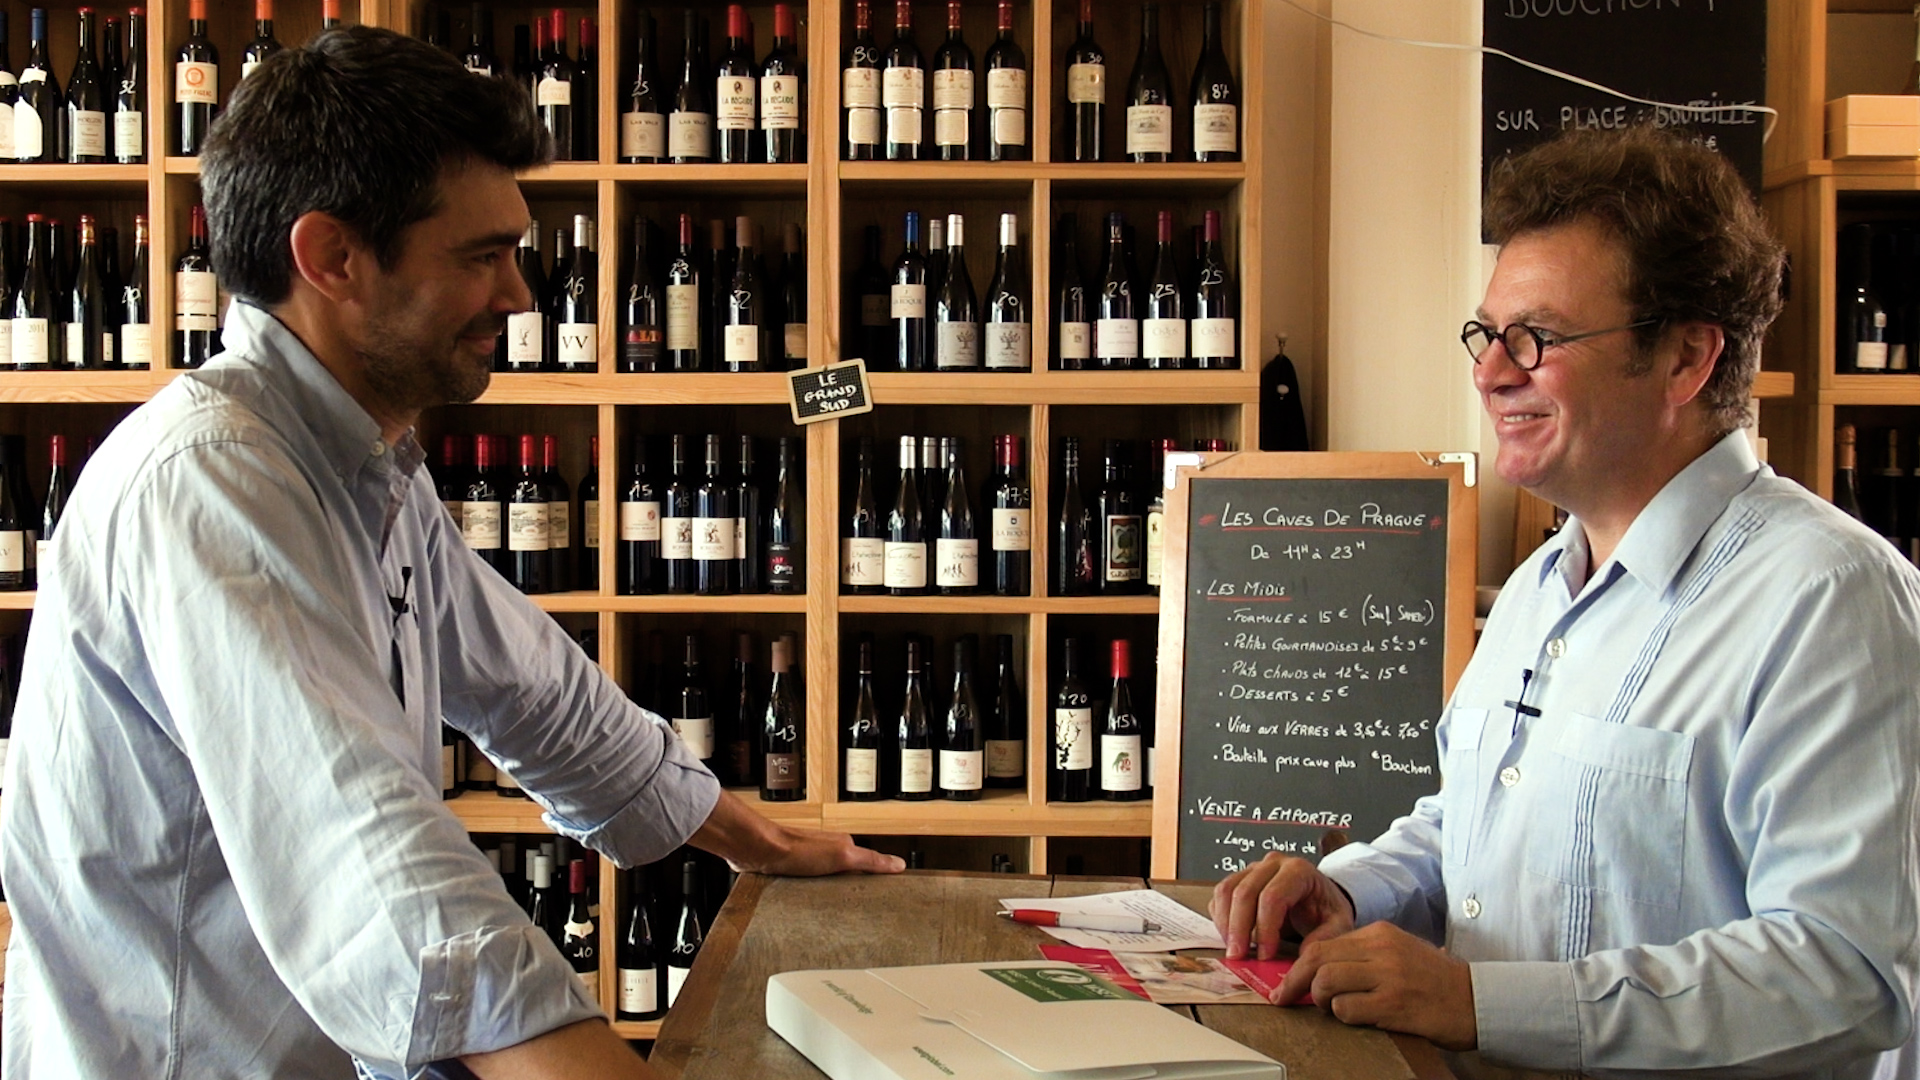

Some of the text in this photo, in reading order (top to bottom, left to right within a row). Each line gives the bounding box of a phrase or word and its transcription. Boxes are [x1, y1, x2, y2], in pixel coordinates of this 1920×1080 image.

[119, 80, 136, 94] 32
[631, 80, 649, 98] 25
[1496, 109, 1540, 131] SUR
[1560, 106, 1628, 130] PLACE
[564, 270, 584, 295] 16
[1201, 269, 1224, 286] 25
[1106, 280, 1129, 298] 26
[1154, 284, 1176, 298] 25
[818, 372, 838, 388] LE
[804, 384, 857, 404] GRAND
[820, 399, 850, 413] SUD
[630, 483, 652, 498] 15
[1221, 502, 1426, 528] LES CAVES DE PRAGUE
[1250, 544, 1270, 560] De
[1207, 580, 1234, 596] LES
[1233, 607, 1293, 624] FORMULE
[1362, 640, 1375, 652] de
[1312, 668, 1326, 680] de
[1230, 684, 1299, 702] DESSERTS
[775, 724, 797, 742] 13
[1284, 720, 1328, 736] VERRES
[1335, 724, 1347, 737] de
[1222, 744, 1268, 764] Bouteille
[1275, 754, 1300, 773] prix
[1302, 758, 1330, 768] cave
[1334, 756, 1357, 774] plus
[1198, 796, 1352, 828] VENTE A EMPORTER
[1223, 830, 1255, 852] Large
[1302, 842, 1316, 854] de
[573, 946, 593, 959] 10
